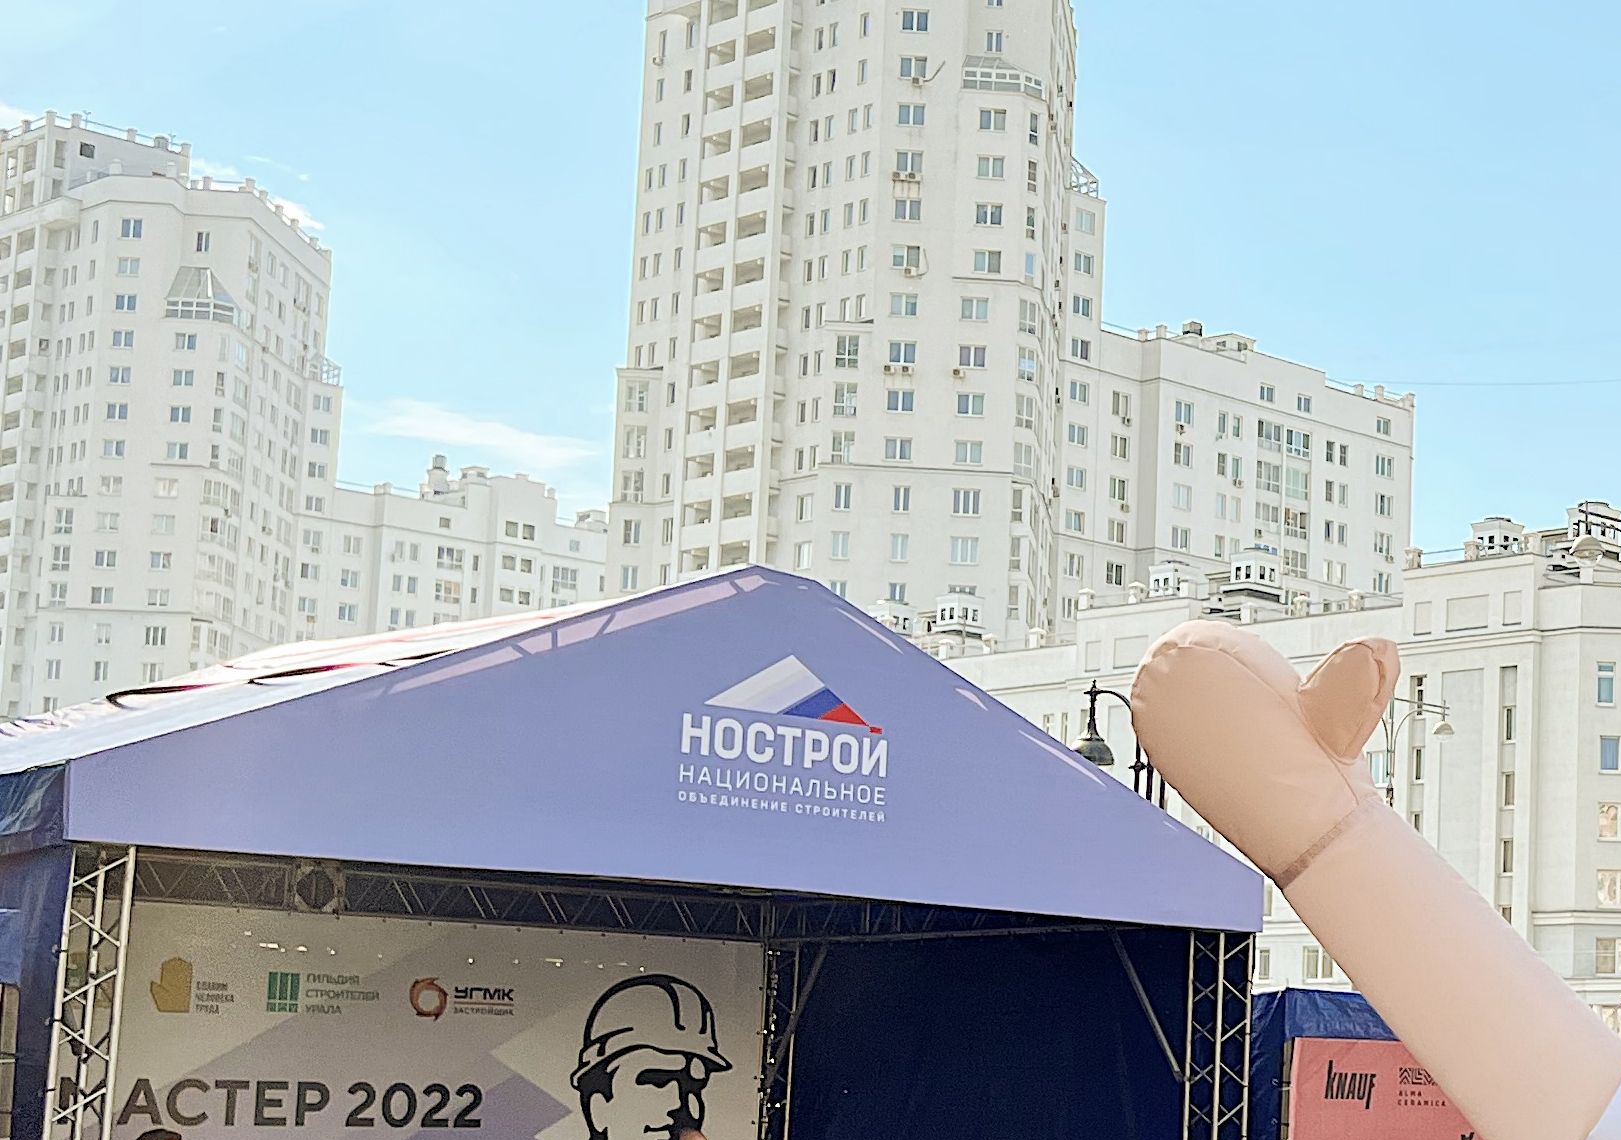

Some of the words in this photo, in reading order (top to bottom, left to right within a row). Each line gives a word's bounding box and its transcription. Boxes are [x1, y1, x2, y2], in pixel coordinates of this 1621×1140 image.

[681, 712, 888, 778] НОСТРОЙ
[679, 763, 886, 806] НАЦИОНАЛЬНОЕ
[678, 790, 788, 813] ОБЪЕДИНЕНИЕ
[795, 804, 885, 823] СТРОИТЕЛЕЙ
[306, 972, 361, 986] ГИЛЬДИЯ
[305, 988, 380, 1001] СТРОИТЕЛЕЙ
[454, 986, 515, 1002] УГМК
[305, 1003, 343, 1015] УРАЛА
[453, 1006, 515, 1017] ЗАСТРОЙЩИК
[1324, 1060, 1377, 1110] KNAUF
[1398, 1090, 1423, 1098] ALMA
[345, 1081, 483, 1129] 2022
[1397, 1099, 1447, 1108] CERAMICA
